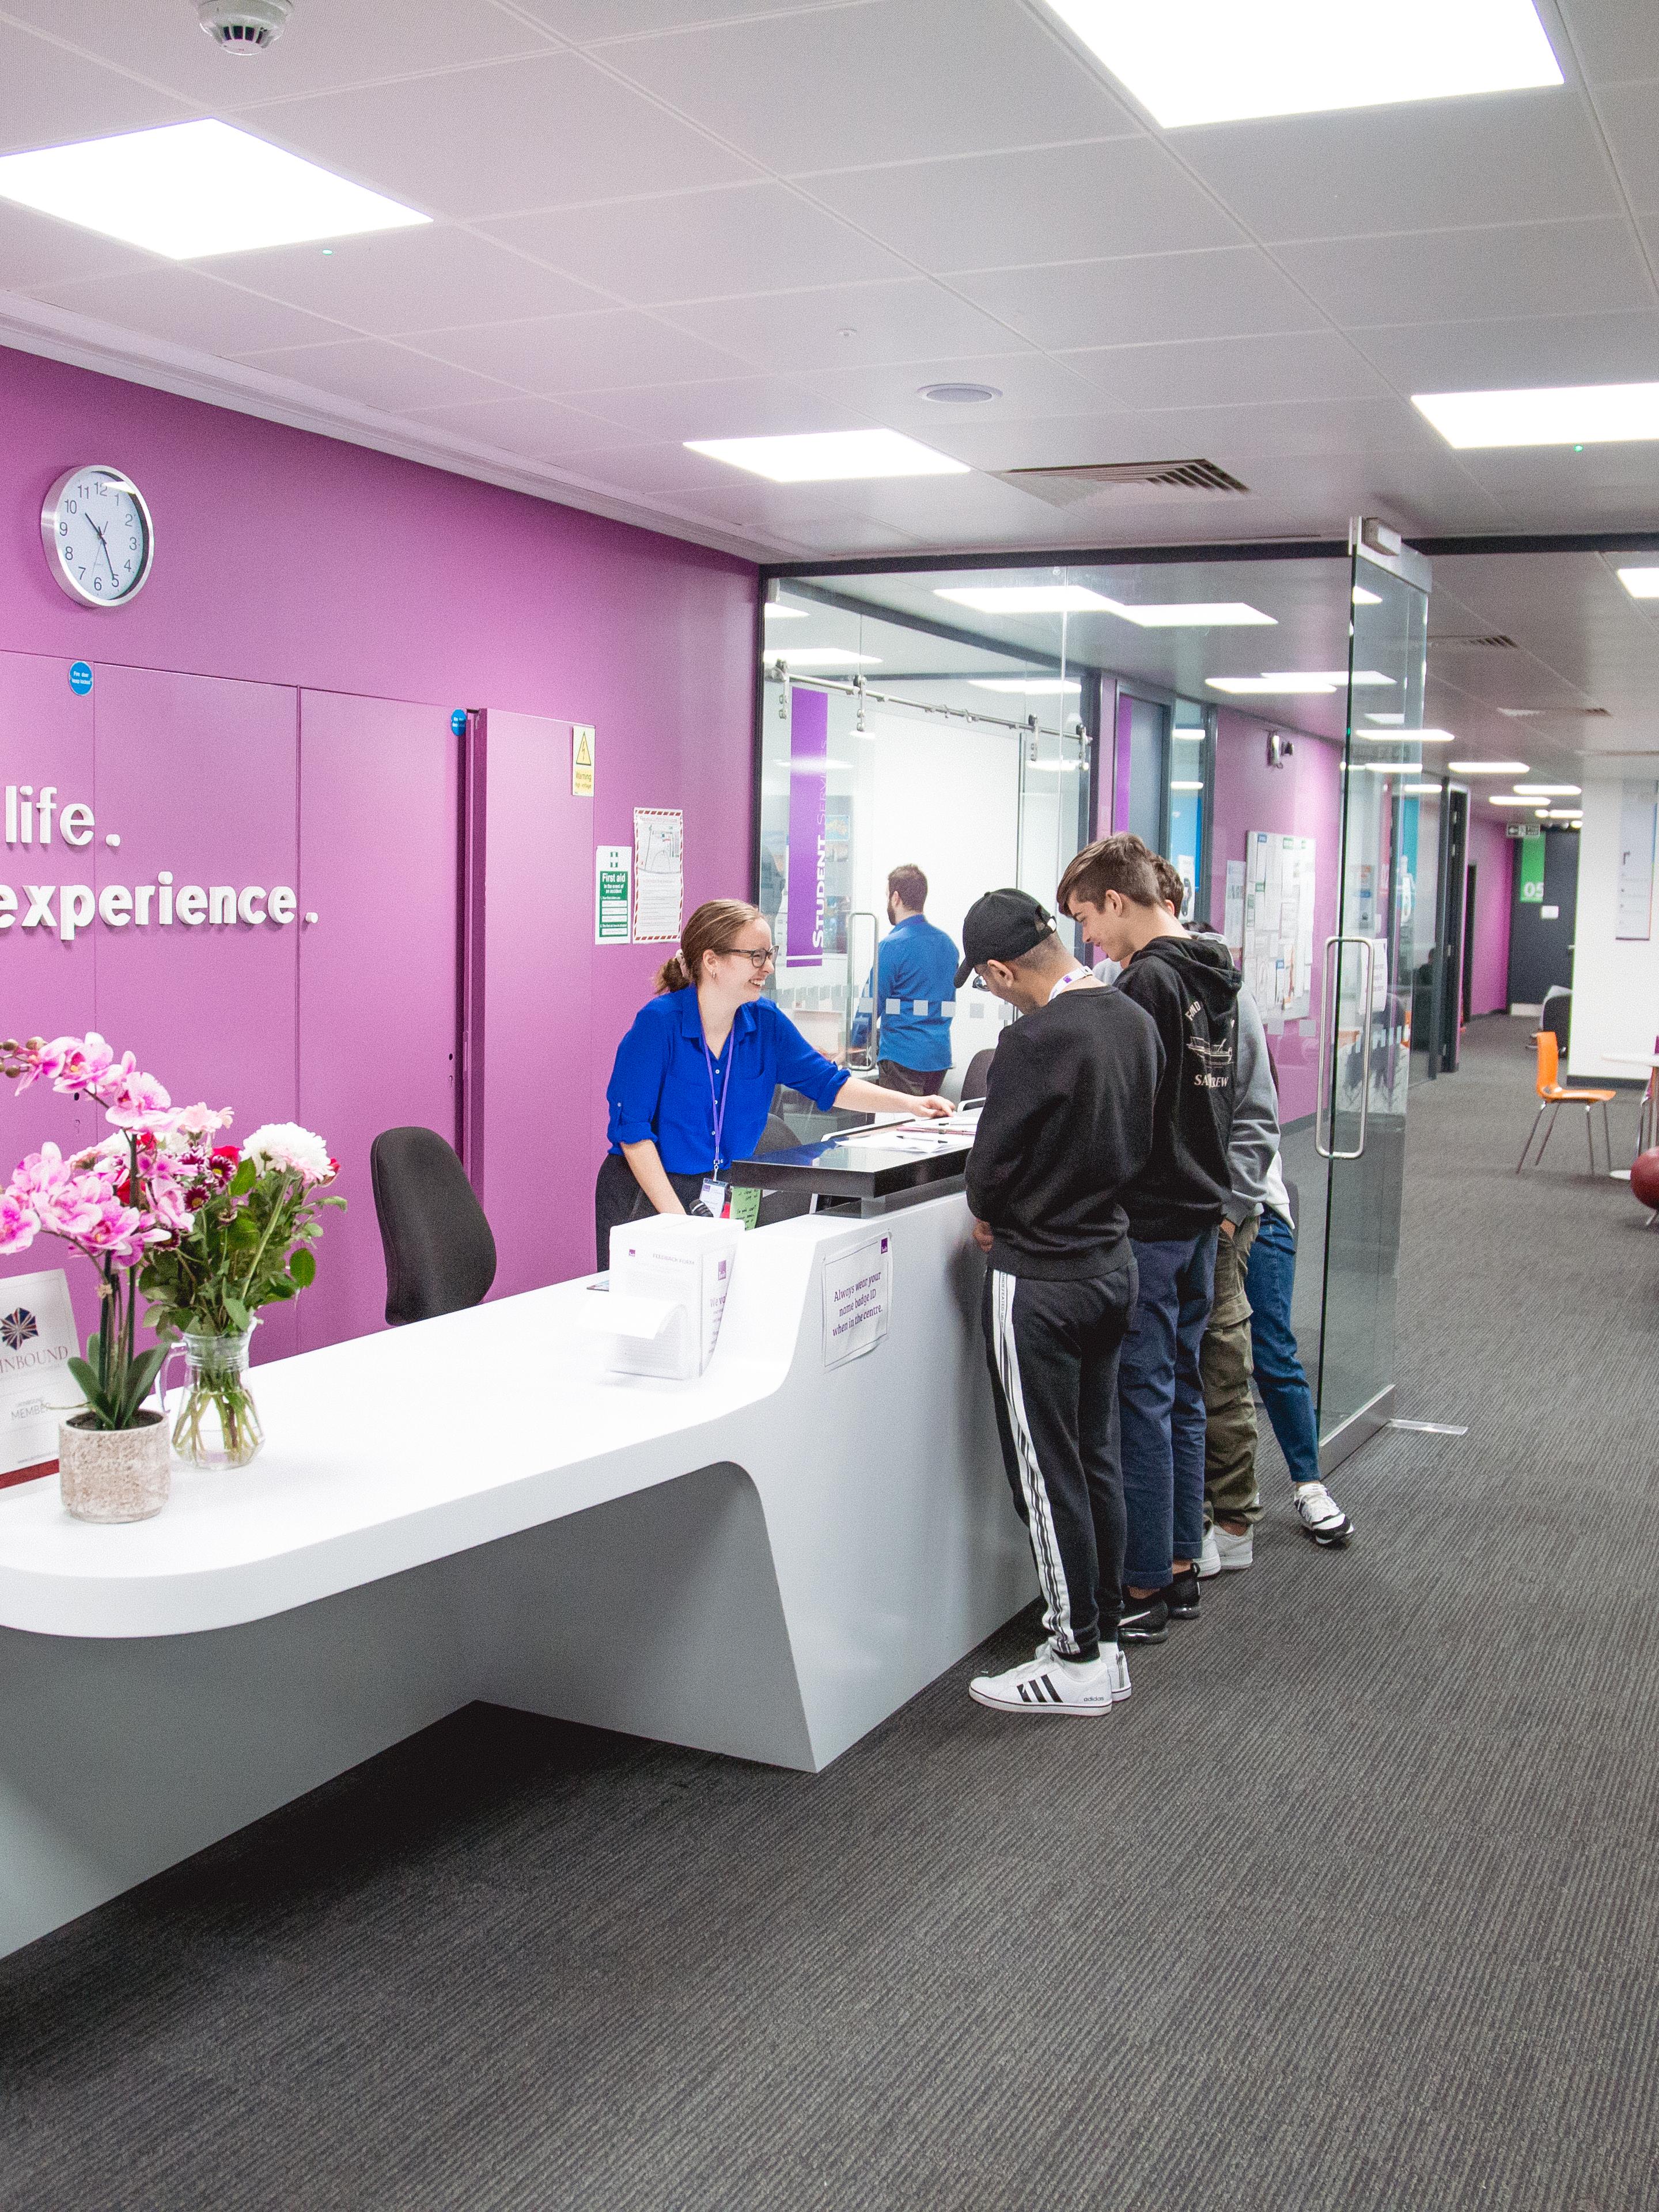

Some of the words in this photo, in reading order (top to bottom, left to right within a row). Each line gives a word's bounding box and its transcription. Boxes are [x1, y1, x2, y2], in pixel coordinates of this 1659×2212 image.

[77, 485, 89, 499] 11
[94, 482, 108, 497] 12
[65, 499, 77, 514] 10
[115, 493, 119, 506] 1
[125, 514, 133, 527] 2
[60, 522, 68, 536] 9
[130, 537, 137, 551] 3
[65, 546, 73, 560] 8
[124, 559, 132, 572] 4
[78, 566, 86, 580] 7
[94, 577, 102, 591] 6
[112, 574, 119, 588] 5
[817, 740, 827, 824] SERVIES
[5, 785, 121, 847] life.
[602, 873, 616, 882] First
[616, 873, 626, 882] aid
[812, 835, 825, 948] STUDENT
[1524, 881, 1544, 897] 05
[834, 1285, 855, 1302] Always
[855, 1278, 868, 1291] wear
[868, 1272, 881, 1287] your
[839, 1301, 854, 1317] name
[855, 1293, 869, 1309] badge
[870, 1288, 876, 1300] ID
[832, 1322, 848, 1336] when
[849, 1318, 855, 1328] in
[855, 1312, 863, 1325] the
[863, 1304, 883, 1320] centre.
